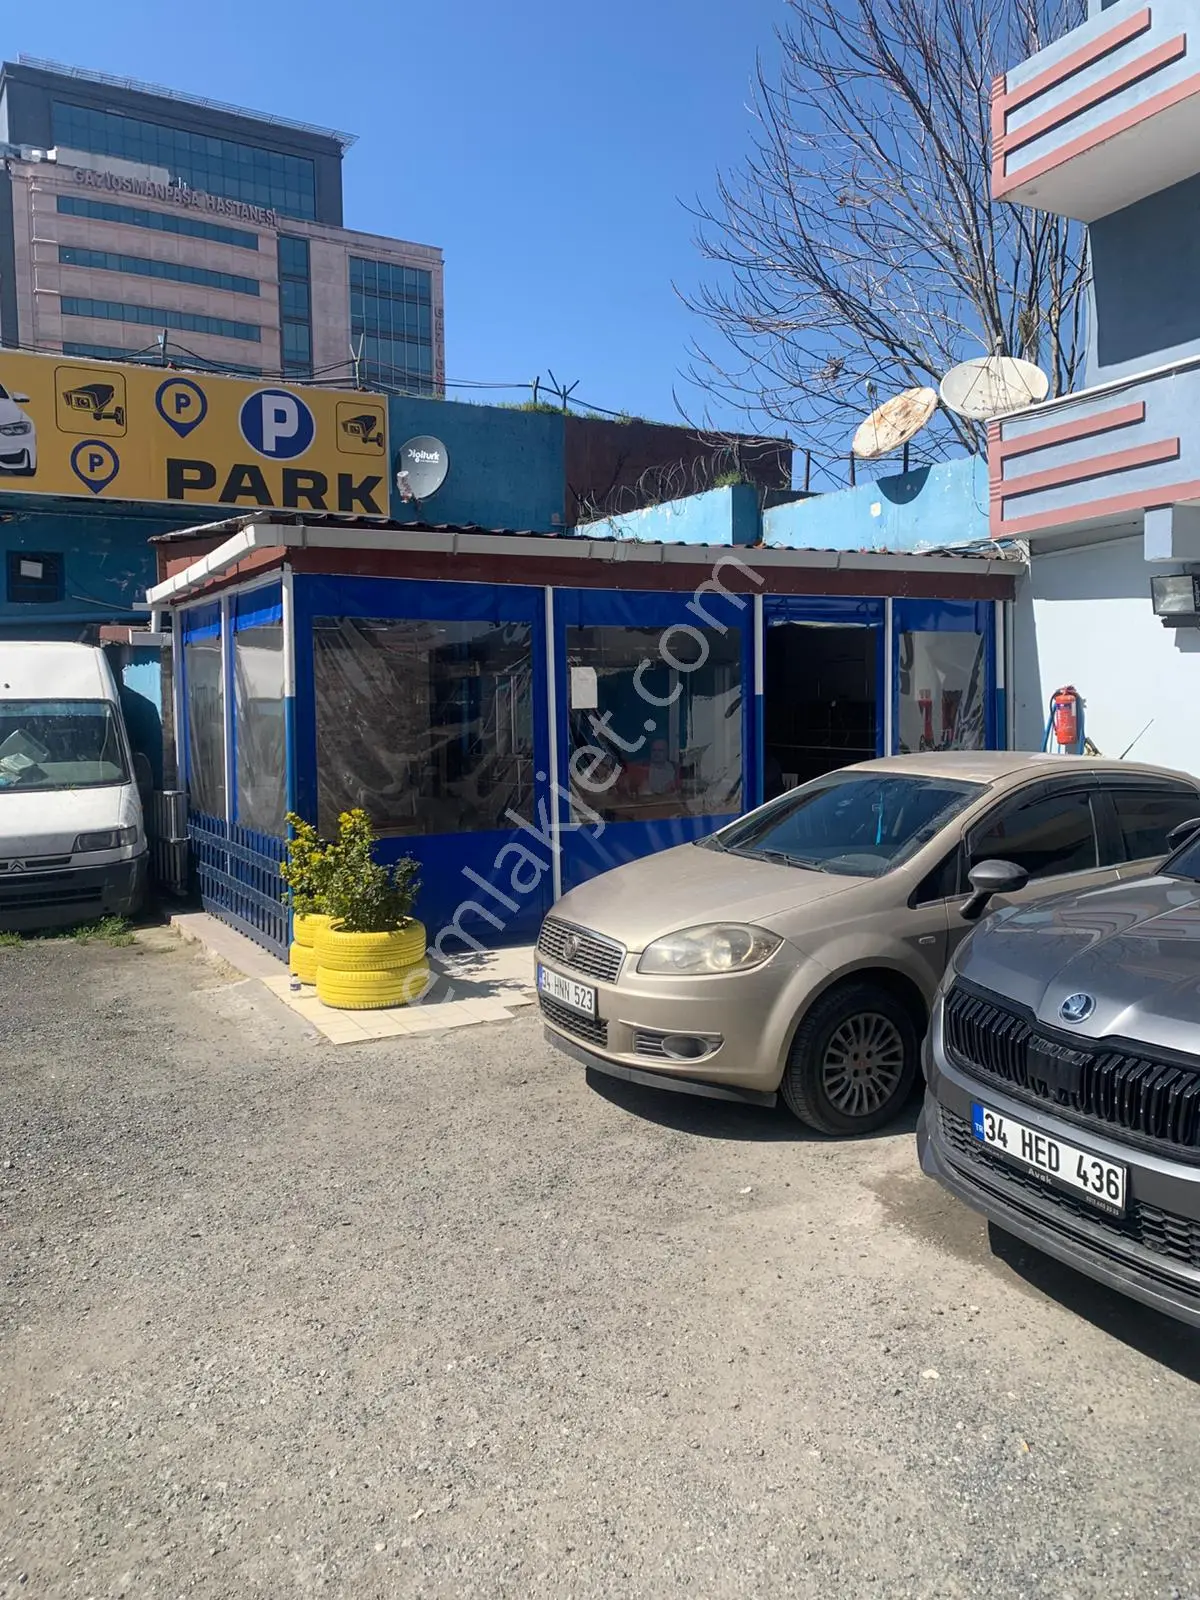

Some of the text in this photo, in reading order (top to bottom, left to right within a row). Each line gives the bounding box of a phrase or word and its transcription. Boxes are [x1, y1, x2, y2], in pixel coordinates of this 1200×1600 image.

[175, 392, 191, 415] P
[262, 394, 299, 452] P
[89, 453, 104, 472] P
[166, 457, 385, 514] PARK
[574, 985, 593, 1010] 523
[985, 1113, 1008, 1149] 34
[1021, 1129, 1060, 1173] HED
[1076, 1155, 1120, 1201] 436
